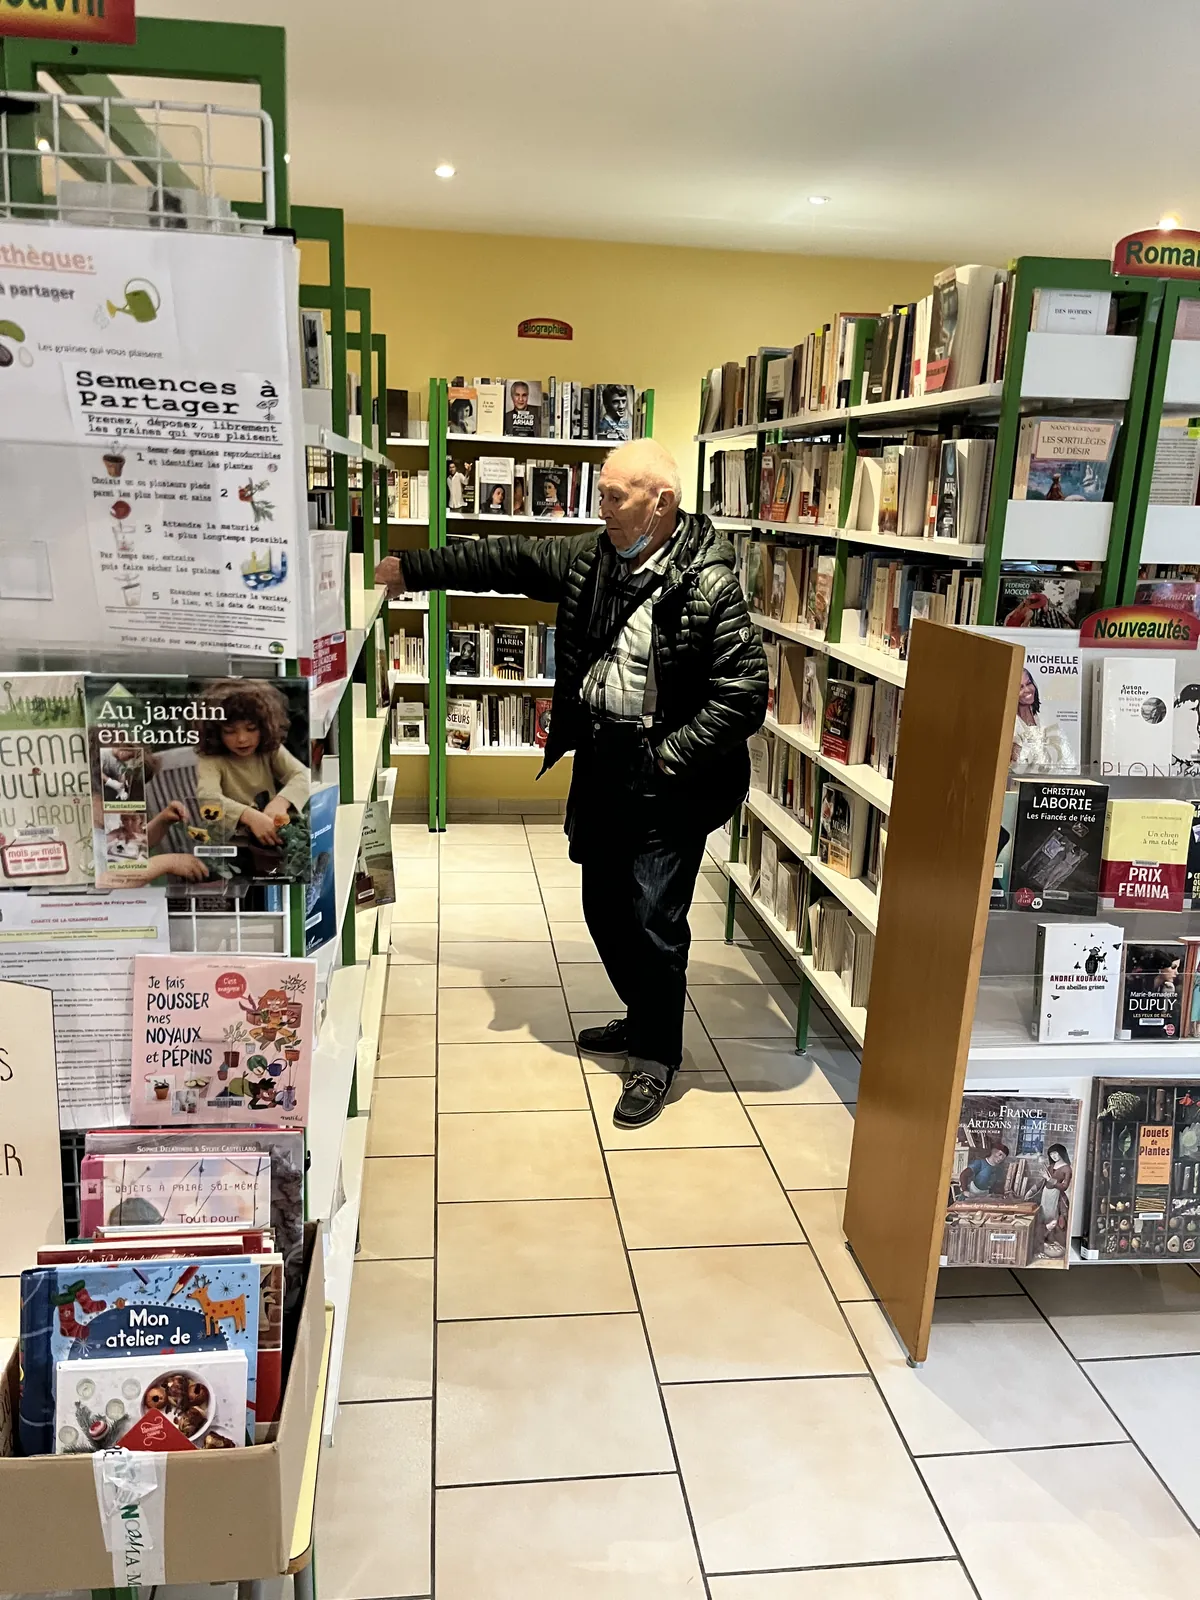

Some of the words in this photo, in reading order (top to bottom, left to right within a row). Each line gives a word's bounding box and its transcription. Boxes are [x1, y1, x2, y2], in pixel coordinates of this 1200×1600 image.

[0, 244, 93, 271] thèque:
[10, 285, 75, 302] partager
[523, 322, 568, 335] Biographies
[38, 343, 52, 351] Les
[55, 345, 86, 354] graines
[90, 347, 103, 355] qui
[76, 370, 237, 395] Semences
[260, 379, 278, 398] à
[79, 391, 240, 417] Partager
[88, 414, 138, 428] Prenez,
[146, 417, 204, 430] déposez,
[213, 421, 278, 433] librement
[89, 424, 108, 433] les
[115, 426, 161, 436] graines
[168, 430, 187, 439] qui
[226, 433, 279, 442] plaisent
[1042, 436, 1056, 444] LES
[1057, 435, 1107, 446] SORTILÈGES
[190, 448, 219, 457] graines
[1053, 446, 1065, 454] DU
[1066, 447, 1090, 455] DÉSIR
[136, 453, 144, 461] 1
[223, 461, 253, 471] plantes
[190, 482, 211, 490] pieds
[220, 489, 228, 498] 2
[144, 525, 152, 533] 3
[163, 520, 201, 529] Attendre
[221, 523, 259, 532] maturité
[178, 532, 198, 541] plus
[203, 533, 246, 543] longtemps
[250, 536, 288, 545] possible
[225, 562, 232, 571] 4
[152, 591, 160, 600] 5
[1094, 618, 1191, 641] Nouveautés
[497, 638, 523, 646] HARRIS
[1026, 655, 1079, 665] MICHELLE
[1040, 666, 1079, 675] OBAMA
[97, 701, 135, 720] Au
[142, 701, 227, 725] jardin
[447, 714, 470, 724] SŒURS
[98, 725, 200, 744] enfants
[0, 771, 89, 800] ULTURE
[1041, 787, 1086, 797] CHRISTIAN
[1033, 796, 1092, 811] LABORIE
[1027, 812, 1040, 820] Les
[1041, 812, 1067, 822] Fiancés
[1069, 814, 1078, 822] de
[1080, 815, 1096, 823] l'été
[1161, 838, 1179, 846] table
[8, 848, 28, 858] mois
[42, 847, 61, 856] mois
[1129, 867, 1163, 883] PRIX
[1118, 882, 1170, 899] FEMINA
[148, 975, 163, 990] Je
[166, 975, 185, 990] fais
[1050, 974, 1075, 982] ANDREÏ
[147, 992, 210, 1010] POUSSER
[1129, 998, 1177, 1011] DUPUY
[147, 1013, 171, 1025] mes
[146, 1026, 202, 1046] NOYAUX
[145, 1052, 159, 1064] et
[1000, 1106, 1043, 1119] FRANCE
[967, 1118, 1012, 1129] ARTISANS
[1031, 1120, 1074, 1132] MÉTIERS
[1142, 1128, 1169, 1138] Jouets
[137, 1145, 159, 1153] SOPHIE
[1140, 1147, 1170, 1156] Plantes
[115, 1183, 152, 1194] OBJETS
[159, 1181, 166, 1192] À
[210, 1180, 259, 1192] SOI-MÊME
[178, 1213, 208, 1224] Tout
[210, 1215, 240, 1224] pour
[129, 1309, 169, 1327] Mon
[105, 1330, 164, 1349] atelier
[170, 1327, 190, 1345] de
